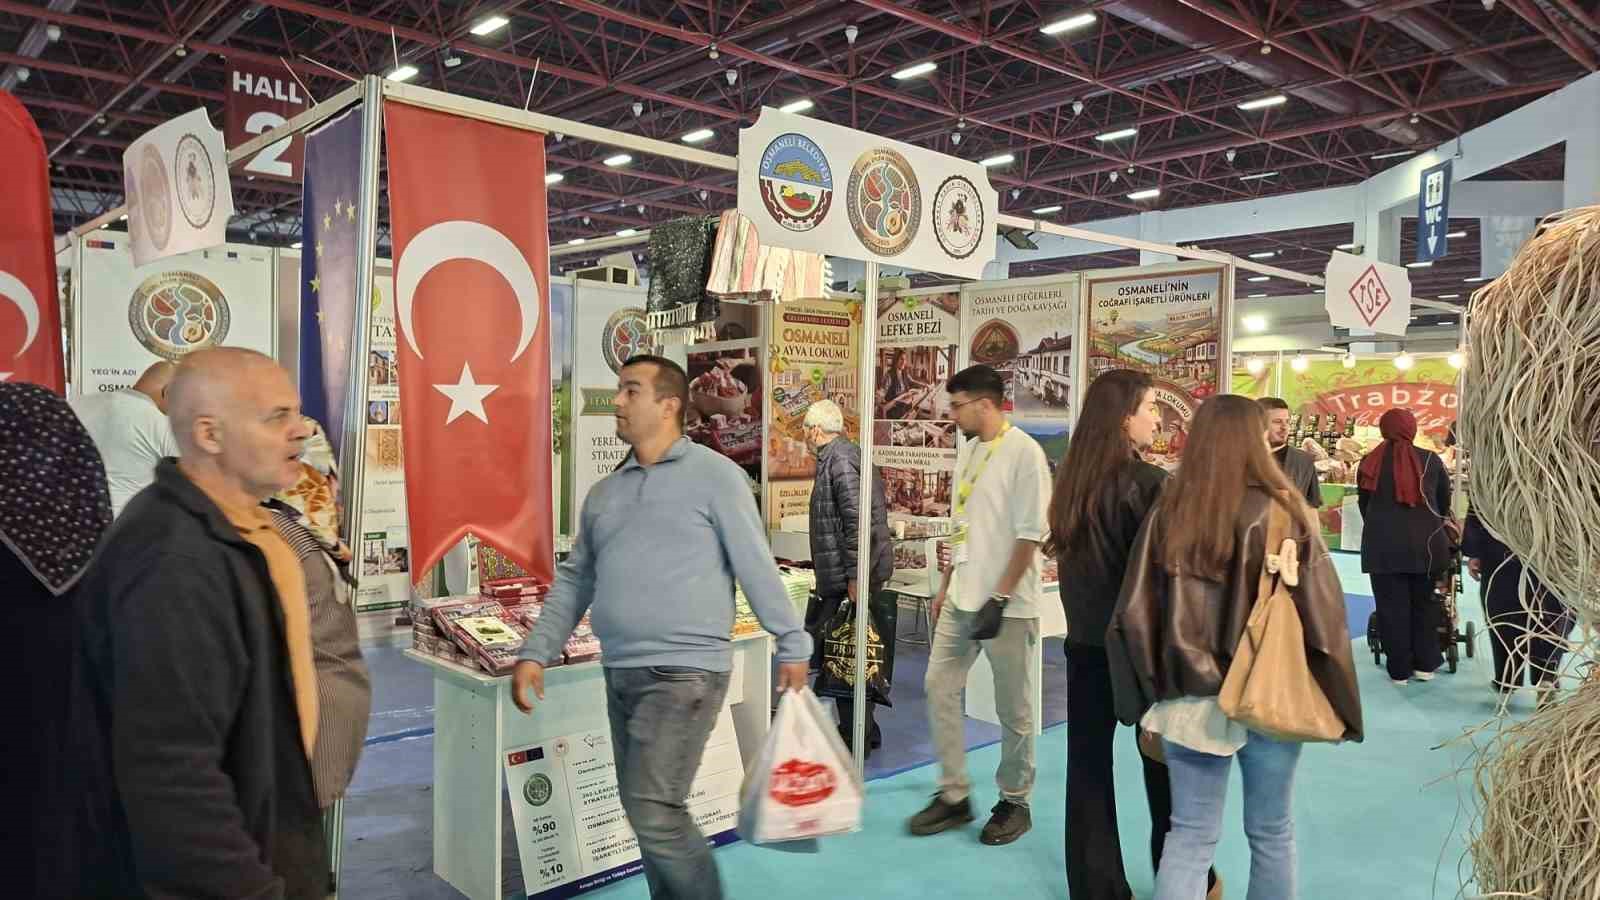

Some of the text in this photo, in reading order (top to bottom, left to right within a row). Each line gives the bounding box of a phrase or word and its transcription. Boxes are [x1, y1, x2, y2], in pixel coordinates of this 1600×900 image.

[233, 70, 302, 104] HALL
[243, 111, 292, 176] 2
[1425, 205, 1442, 224] WC
[1118, 280, 1189, 296] OSMANELİ'NİN
[1360, 278, 1382, 314] TSE
[1098, 290, 1210, 308] COĞRAFİ İŞARETLİ ÜRÜNLERİ
[888, 307, 933, 322] OSMANELİ
[1007, 302, 1031, 314] DOĞA
[881, 318, 942, 337] LEFKE BEZİ
[783, 328, 850, 346] OSMANELİ
[784, 345, 850, 359] AYVA LOKUMU
[98, 383, 133, 392] OSMA
[1163, 393, 1191, 418] LOKUMU
[592, 436, 617, 447] YEREL
[532, 821, 556, 836] %90
[540, 863, 563, 879] %10
